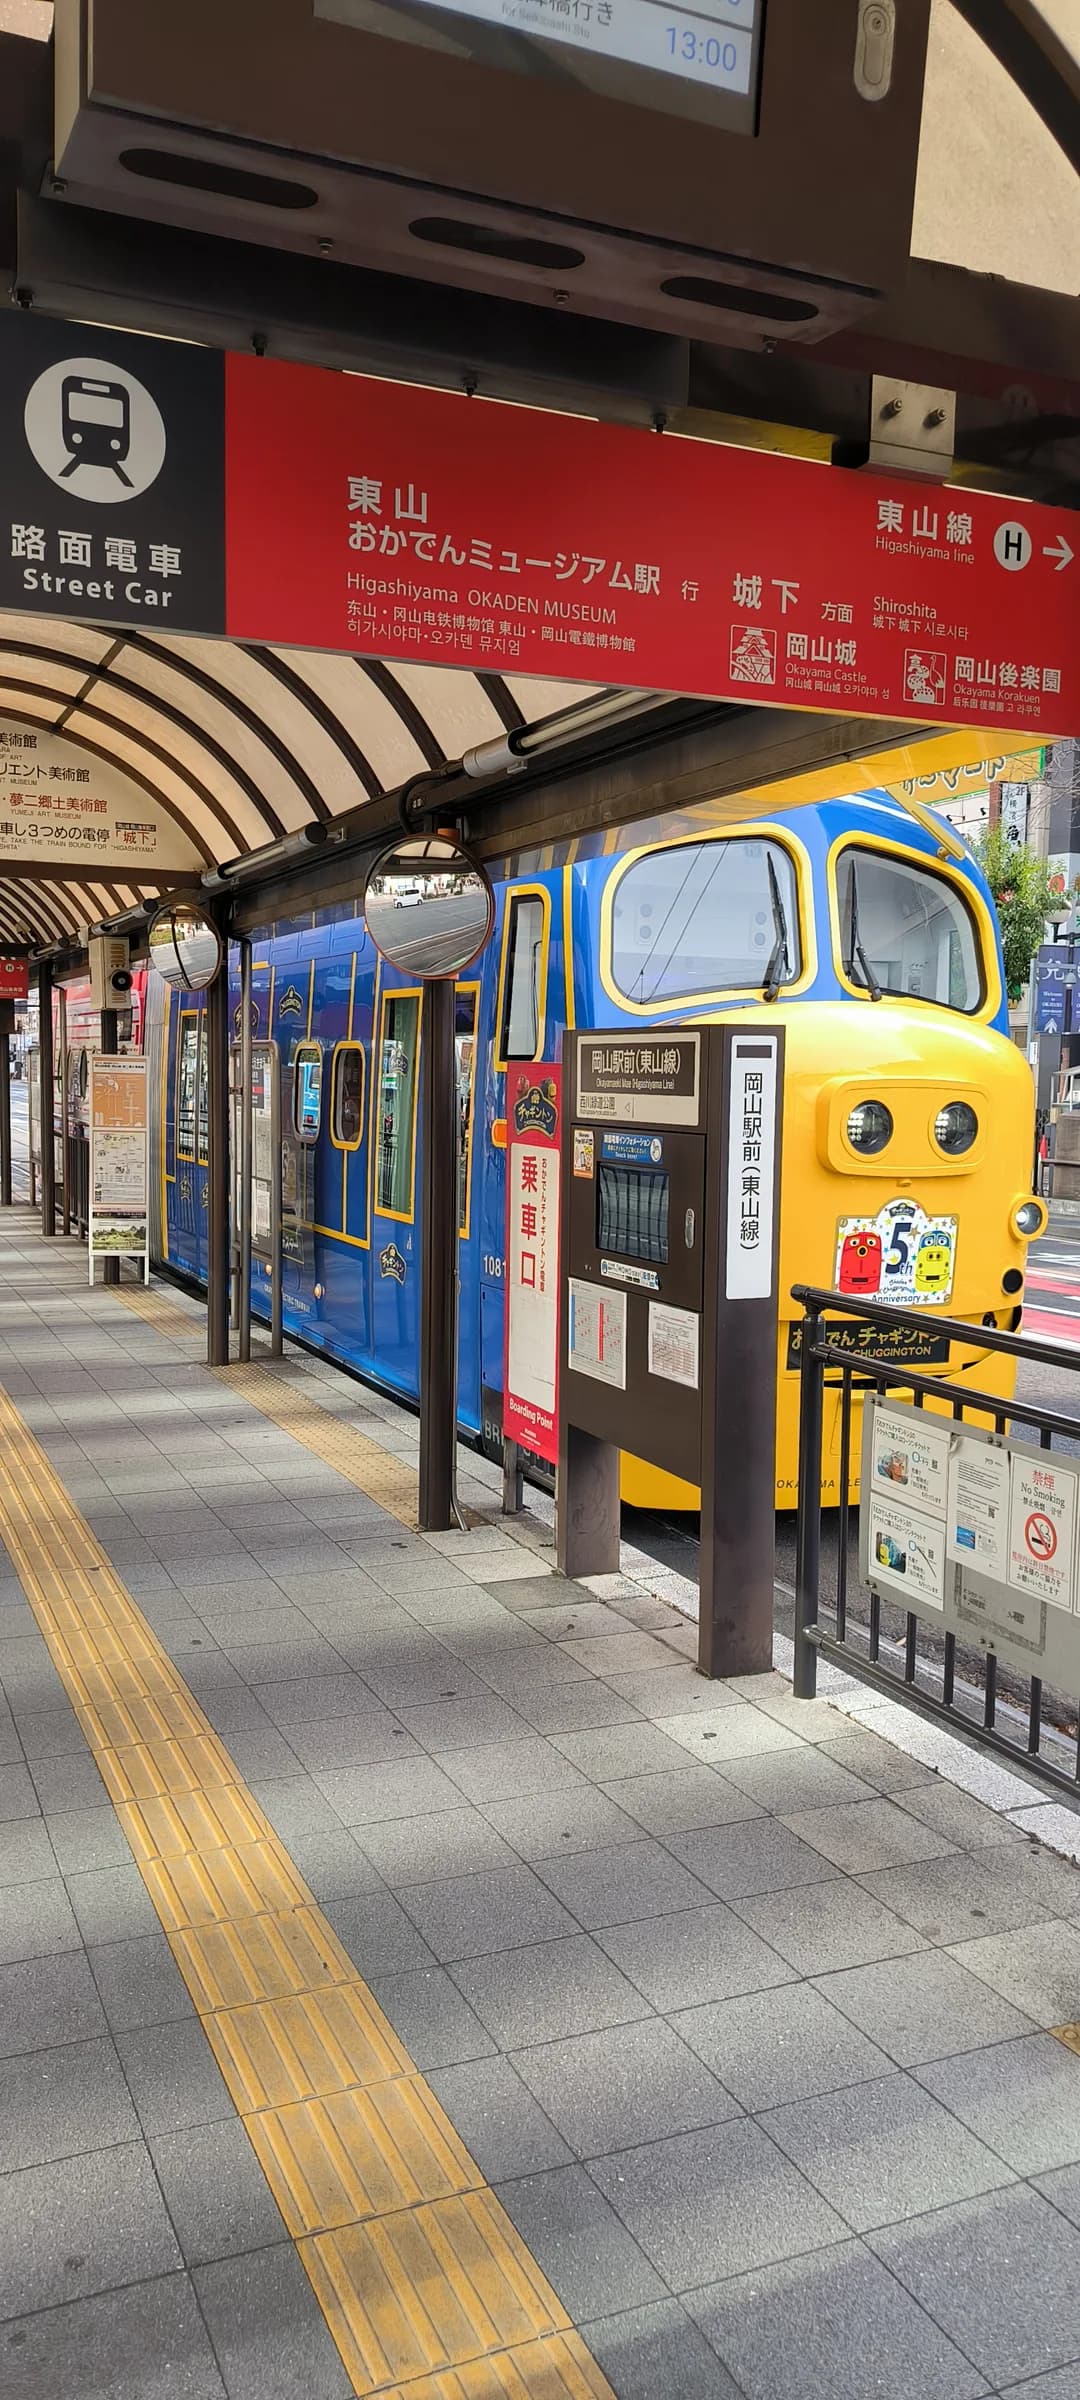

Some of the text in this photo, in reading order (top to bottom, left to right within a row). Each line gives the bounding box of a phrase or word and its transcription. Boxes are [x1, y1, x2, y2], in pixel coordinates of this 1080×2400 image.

[666, 27, 737, 71] 13:00
[347, 476, 428, 523] 東山
[877, 500, 973, 545] 東山線
[11, 524, 182, 577] 路面電車
[348, 521, 699, 601] おかでんミュージアム駅 行
[875, 536, 975, 564] Higashiyama line
[1004, 530, 1022, 561] H
[24, 569, 172, 607] Street Car
[347, 572, 616, 624] Higashiyama OKADEN MUSEUM
[732, 573, 853, 624] 城下 方面
[873, 596, 937, 619] Shiroshita
[480, 636, 520, 656] 뮤지엄
[924, 622, 968, 641] 시로시타
[787, 632, 857, 666] 岡山城
[785, 663, 867, 683] Okayama Castle
[955, 655, 1061, 694] 岡山後楽園
[953, 683, 1040, 704] Okayama Korakuen
[592, 1048, 681, 1075] 岡山駅前(東山線)
[740, 1072, 763, 1251] 岡山駅前(東山線)
[521, 1156, 538, 1289] 乗車口
[885, 1222, 912, 1274] 5
[900, 1262, 913, 1275] th
[872, 1294, 921, 1304] Anniversary
[509, 1397, 553, 1431] Boarding Point
[1021, 1481, 1066, 1509] No Smoking
[1032, 1470, 1055, 1490] 禁煙
